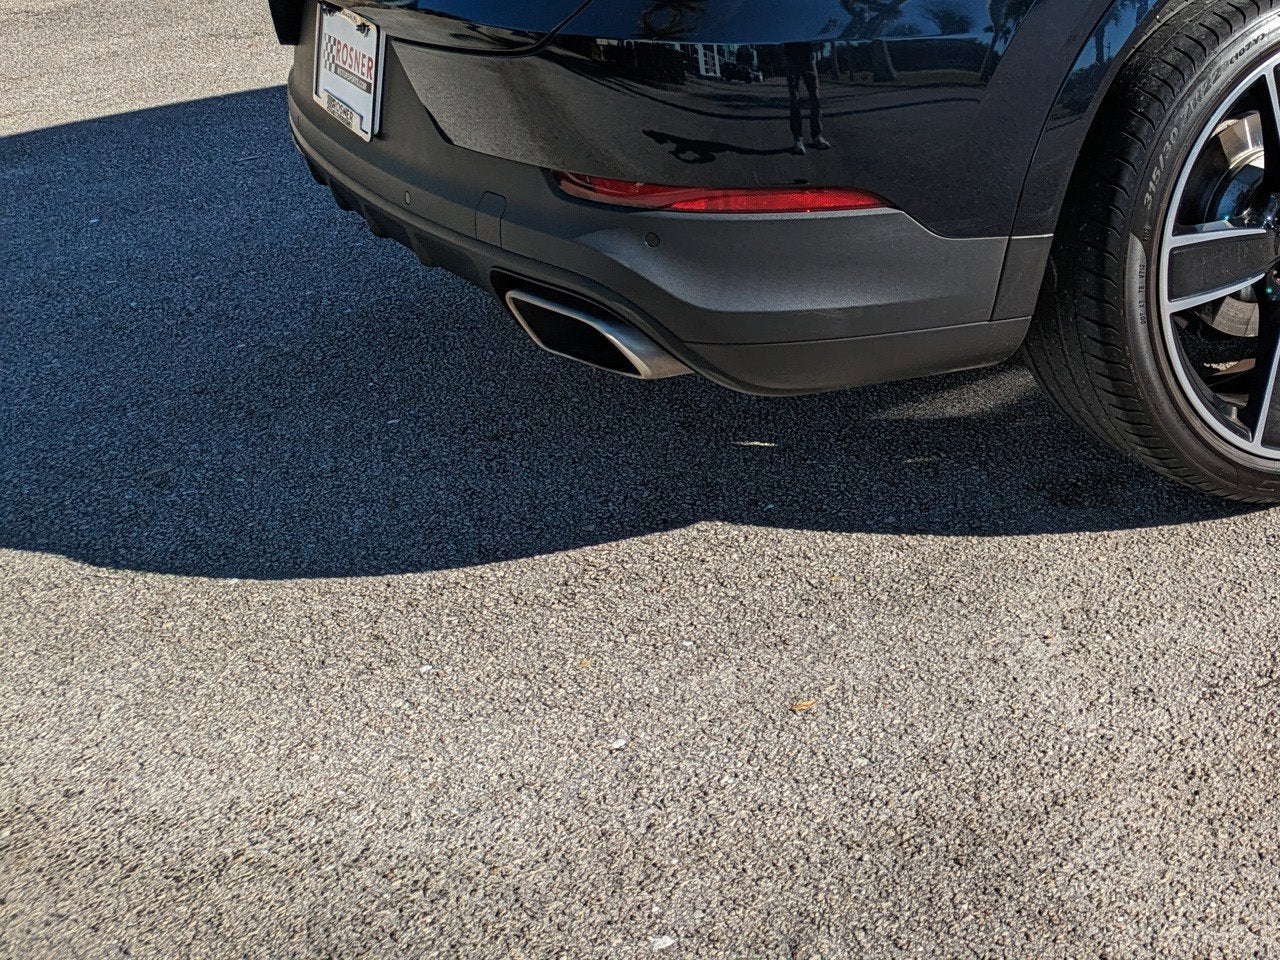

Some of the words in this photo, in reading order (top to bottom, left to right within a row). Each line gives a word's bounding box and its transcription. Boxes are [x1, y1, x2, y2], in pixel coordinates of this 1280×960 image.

[335, 39, 374, 80] ROSNER
[1144, 126, 1179, 209] 315/30
[1229, 33, 1265, 65] (107Y)
